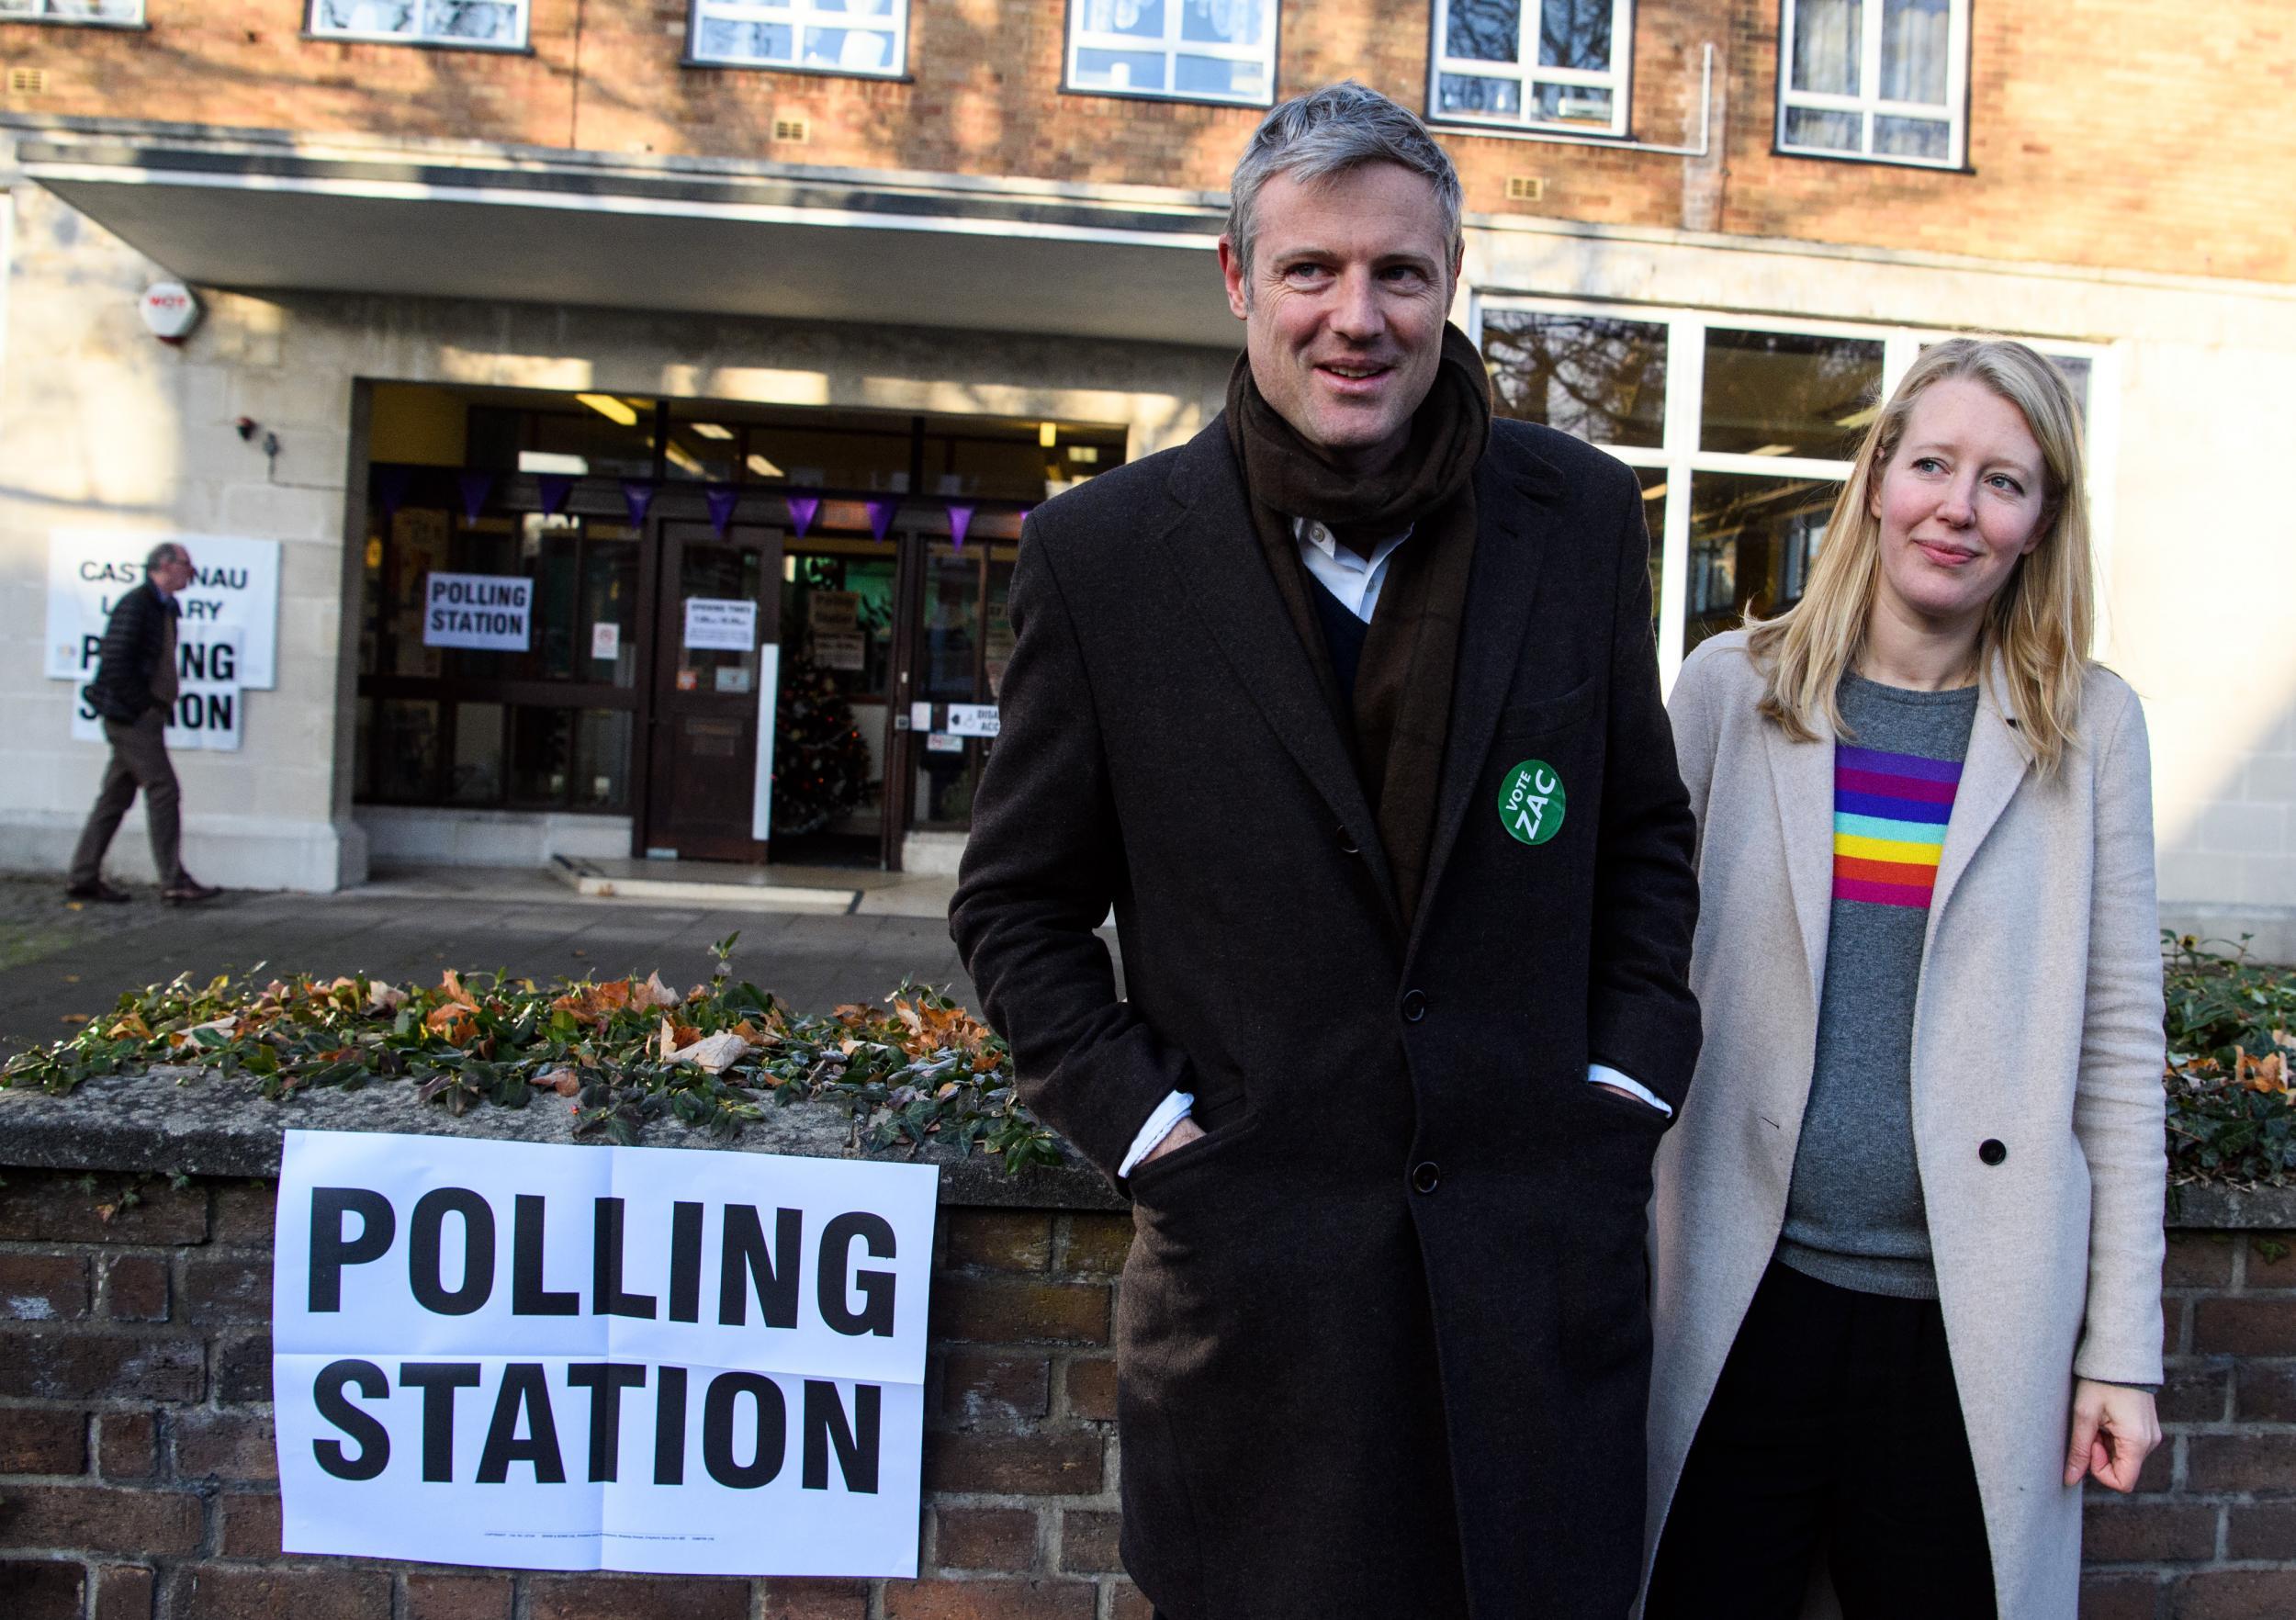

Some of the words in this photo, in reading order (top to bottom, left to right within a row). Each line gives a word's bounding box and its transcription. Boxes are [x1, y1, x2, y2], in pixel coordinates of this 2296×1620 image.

[431, 580, 526, 608] POLLING
[431, 609, 523, 636] STATION
[1505, 770, 1532, 811] VOTE
[1514, 769, 1557, 840] ZAC
[309, 1187, 897, 1338] POLLING
[312, 1358, 882, 1495] STATION
